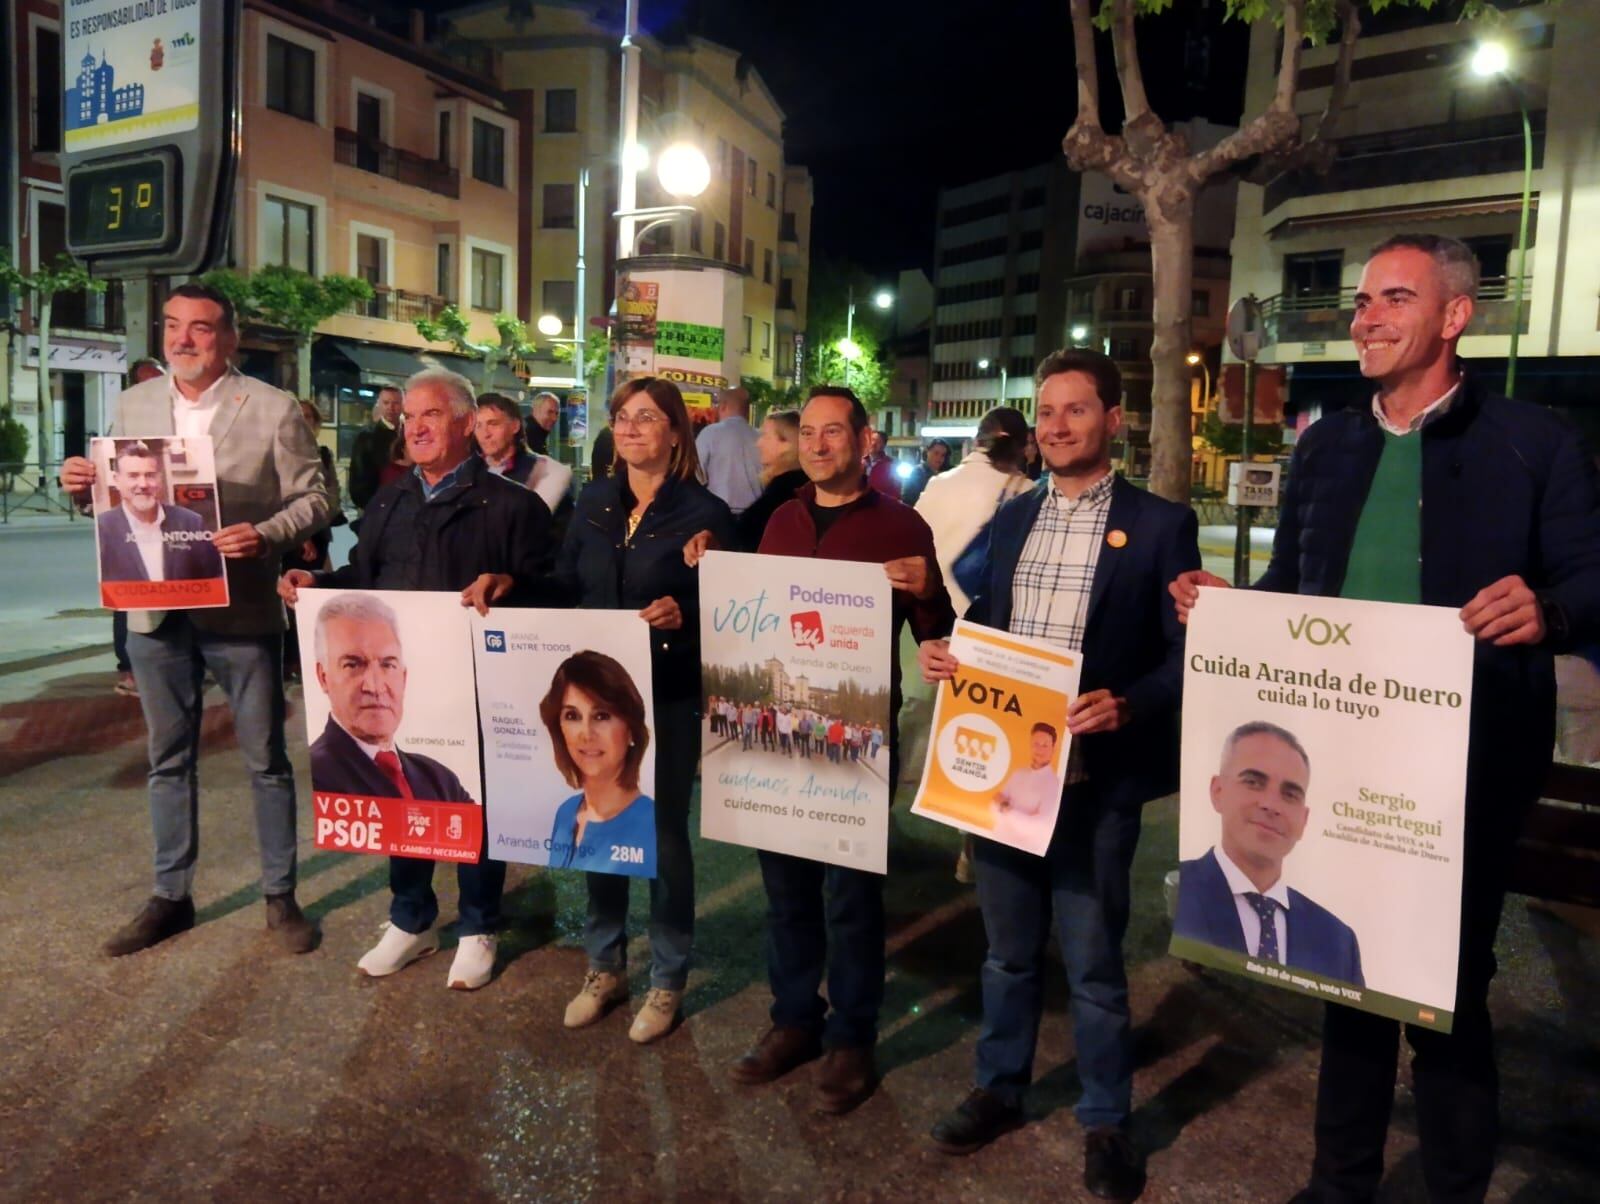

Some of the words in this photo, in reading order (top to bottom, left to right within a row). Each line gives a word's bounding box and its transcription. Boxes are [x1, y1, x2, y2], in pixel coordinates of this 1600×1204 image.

[70, 21, 80, 39] ES
[82, 0, 155, 36] RESPONSABILIDAD
[157, 0, 167, 15] DE
[114, 582, 211, 597] CIUDADANOS
[790, 584, 875, 609] Podemos
[713, 589, 780, 643] vota
[829, 623, 875, 638] izquierda
[1287, 613, 1352, 646] VOX
[511, 643, 538, 651] ENTRE
[830, 637, 859, 650] unida
[789, 655, 825, 668] Aranda
[827, 660, 839, 671] de
[841, 661, 872, 674] Duero
[1190, 653, 1251, 679] Cuida
[1255, 662, 1342, 692] Aranda
[1348, 673, 1377, 696] de
[1383, 678, 1463, 709] Duero
[950, 676, 1022, 717] VOTA
[1257, 685, 1307, 708] cuida
[1312, 691, 1330, 710] lo
[1335, 698, 1380, 720] tuyo
[492, 715, 525, 726] RAQUEL
[405, 737, 445, 746] ILDEFONSO
[317, 795, 382, 819] VOTA
[1358, 786, 1416, 812] Sergio
[407, 814, 431, 826] PSOE
[724, 797, 788, 816] cuidemos
[792, 806, 805, 818] lo
[808, 809, 866, 826] cercano
[1332, 801, 1442, 837] Chagartegui
[317, 817, 383, 850] PSOE
[497, 833, 540, 850] Aranda
[1384, 831, 1394, 841] de
[1397, 835, 1416, 846] VOX
[390, 843, 398, 852] EL
[400, 844, 432, 855] CAMBIO
[432, 847, 477, 859] NECESARIO
[610, 845, 644, 864] 28M
